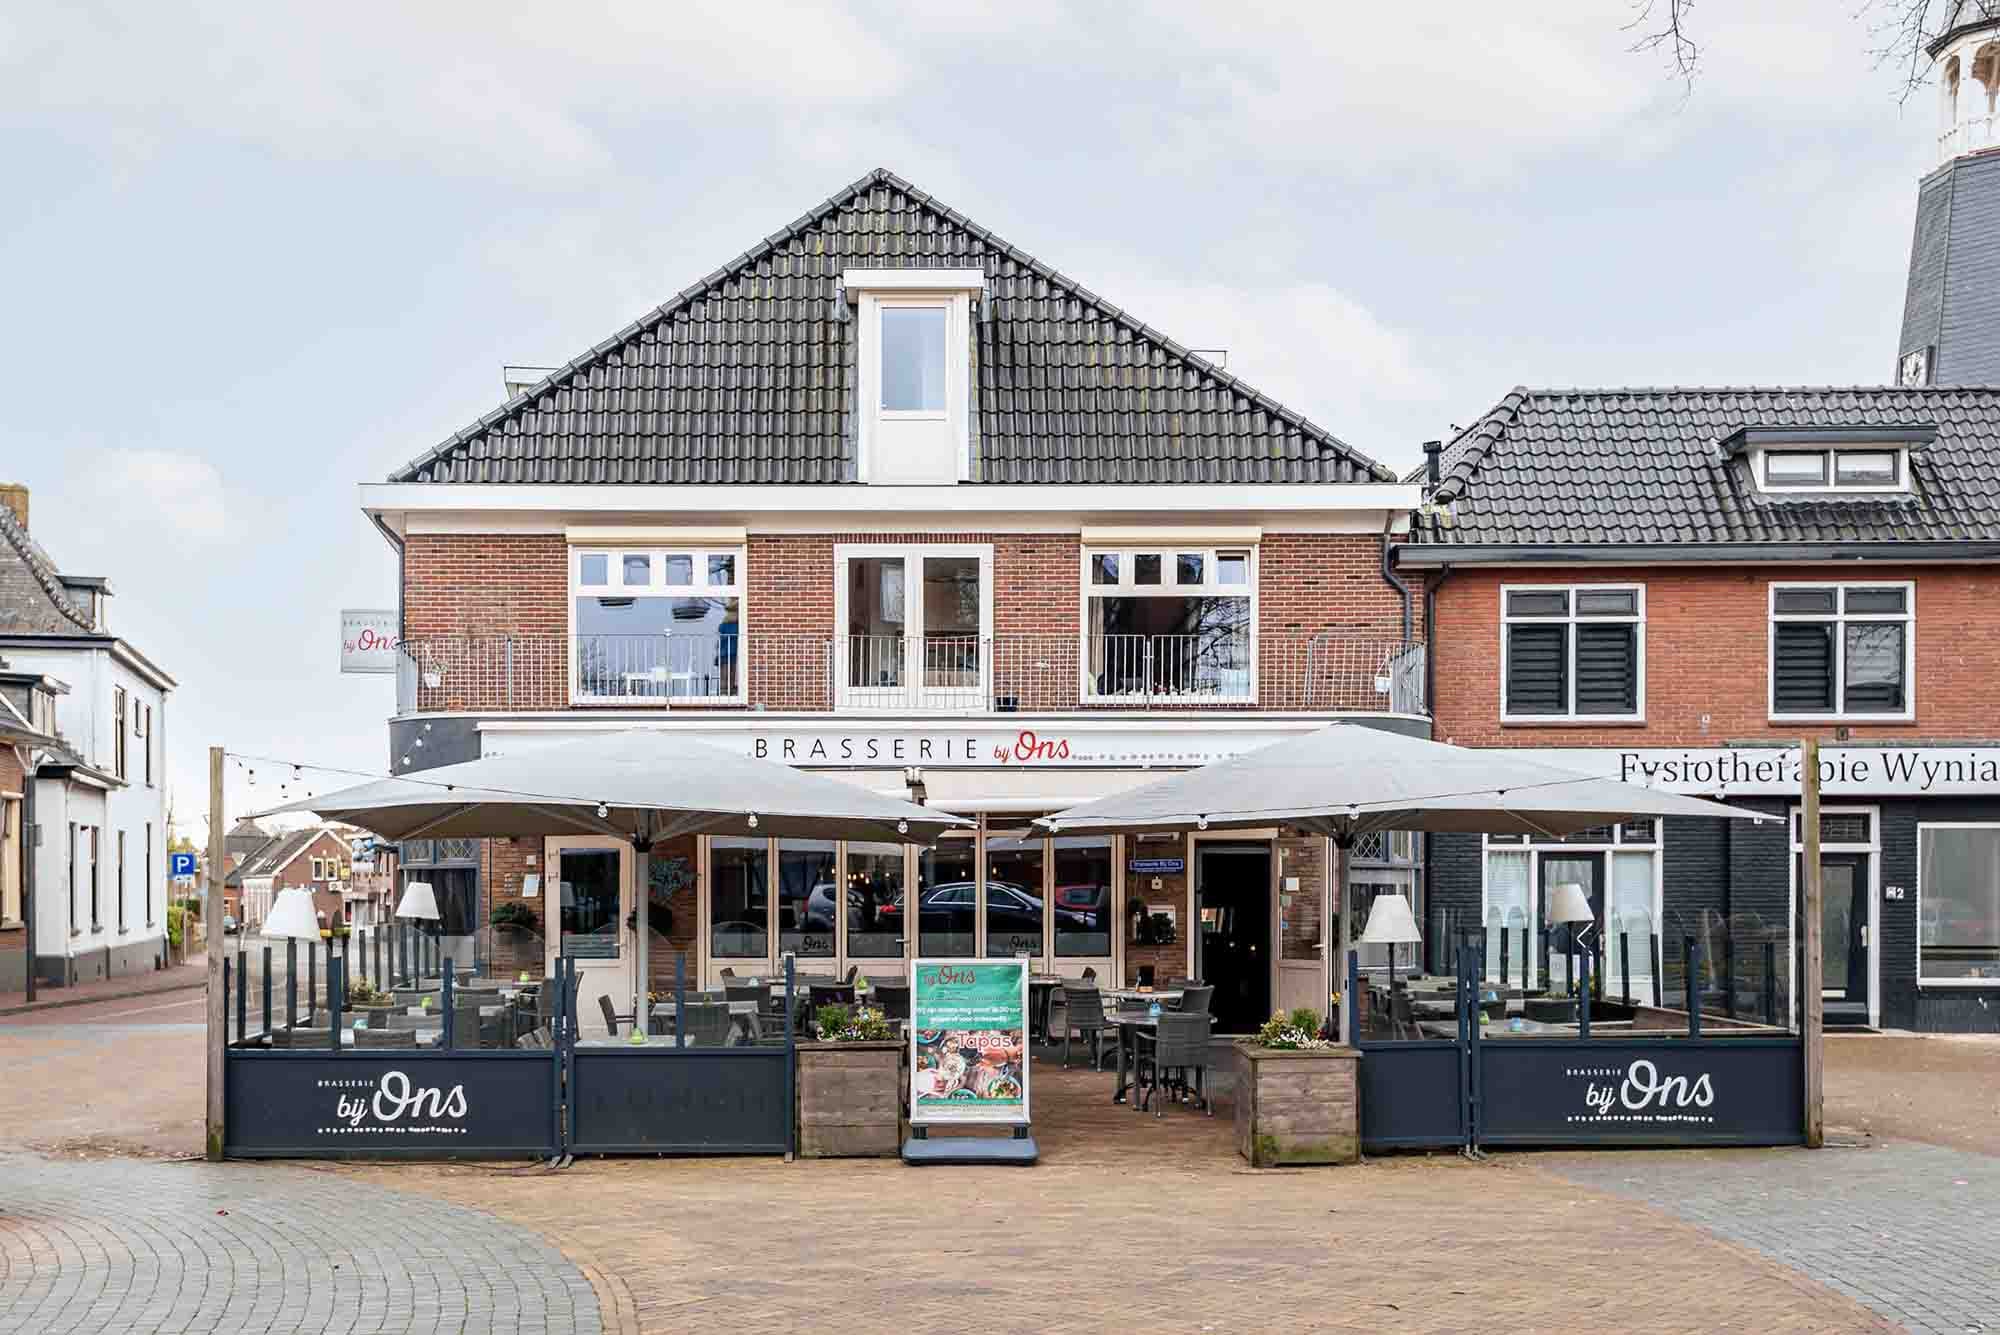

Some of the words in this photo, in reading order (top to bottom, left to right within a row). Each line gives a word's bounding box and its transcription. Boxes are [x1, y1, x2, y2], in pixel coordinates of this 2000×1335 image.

[358, 629, 398, 651] Ons
[754, 737, 978, 760] BRASSERIE
[1013, 729, 1071, 763] Ons
[1880, 752, 1999, 791] Wynia
[176, 856, 190, 873] P
[957, 1033, 1013, 1052] Tapas
[317, 1079, 375, 1088] BRASSERIE
[1620, 1059, 1715, 1110] Ons
[336, 1093, 370, 1127] bij
[372, 1070, 468, 1122] Ons
